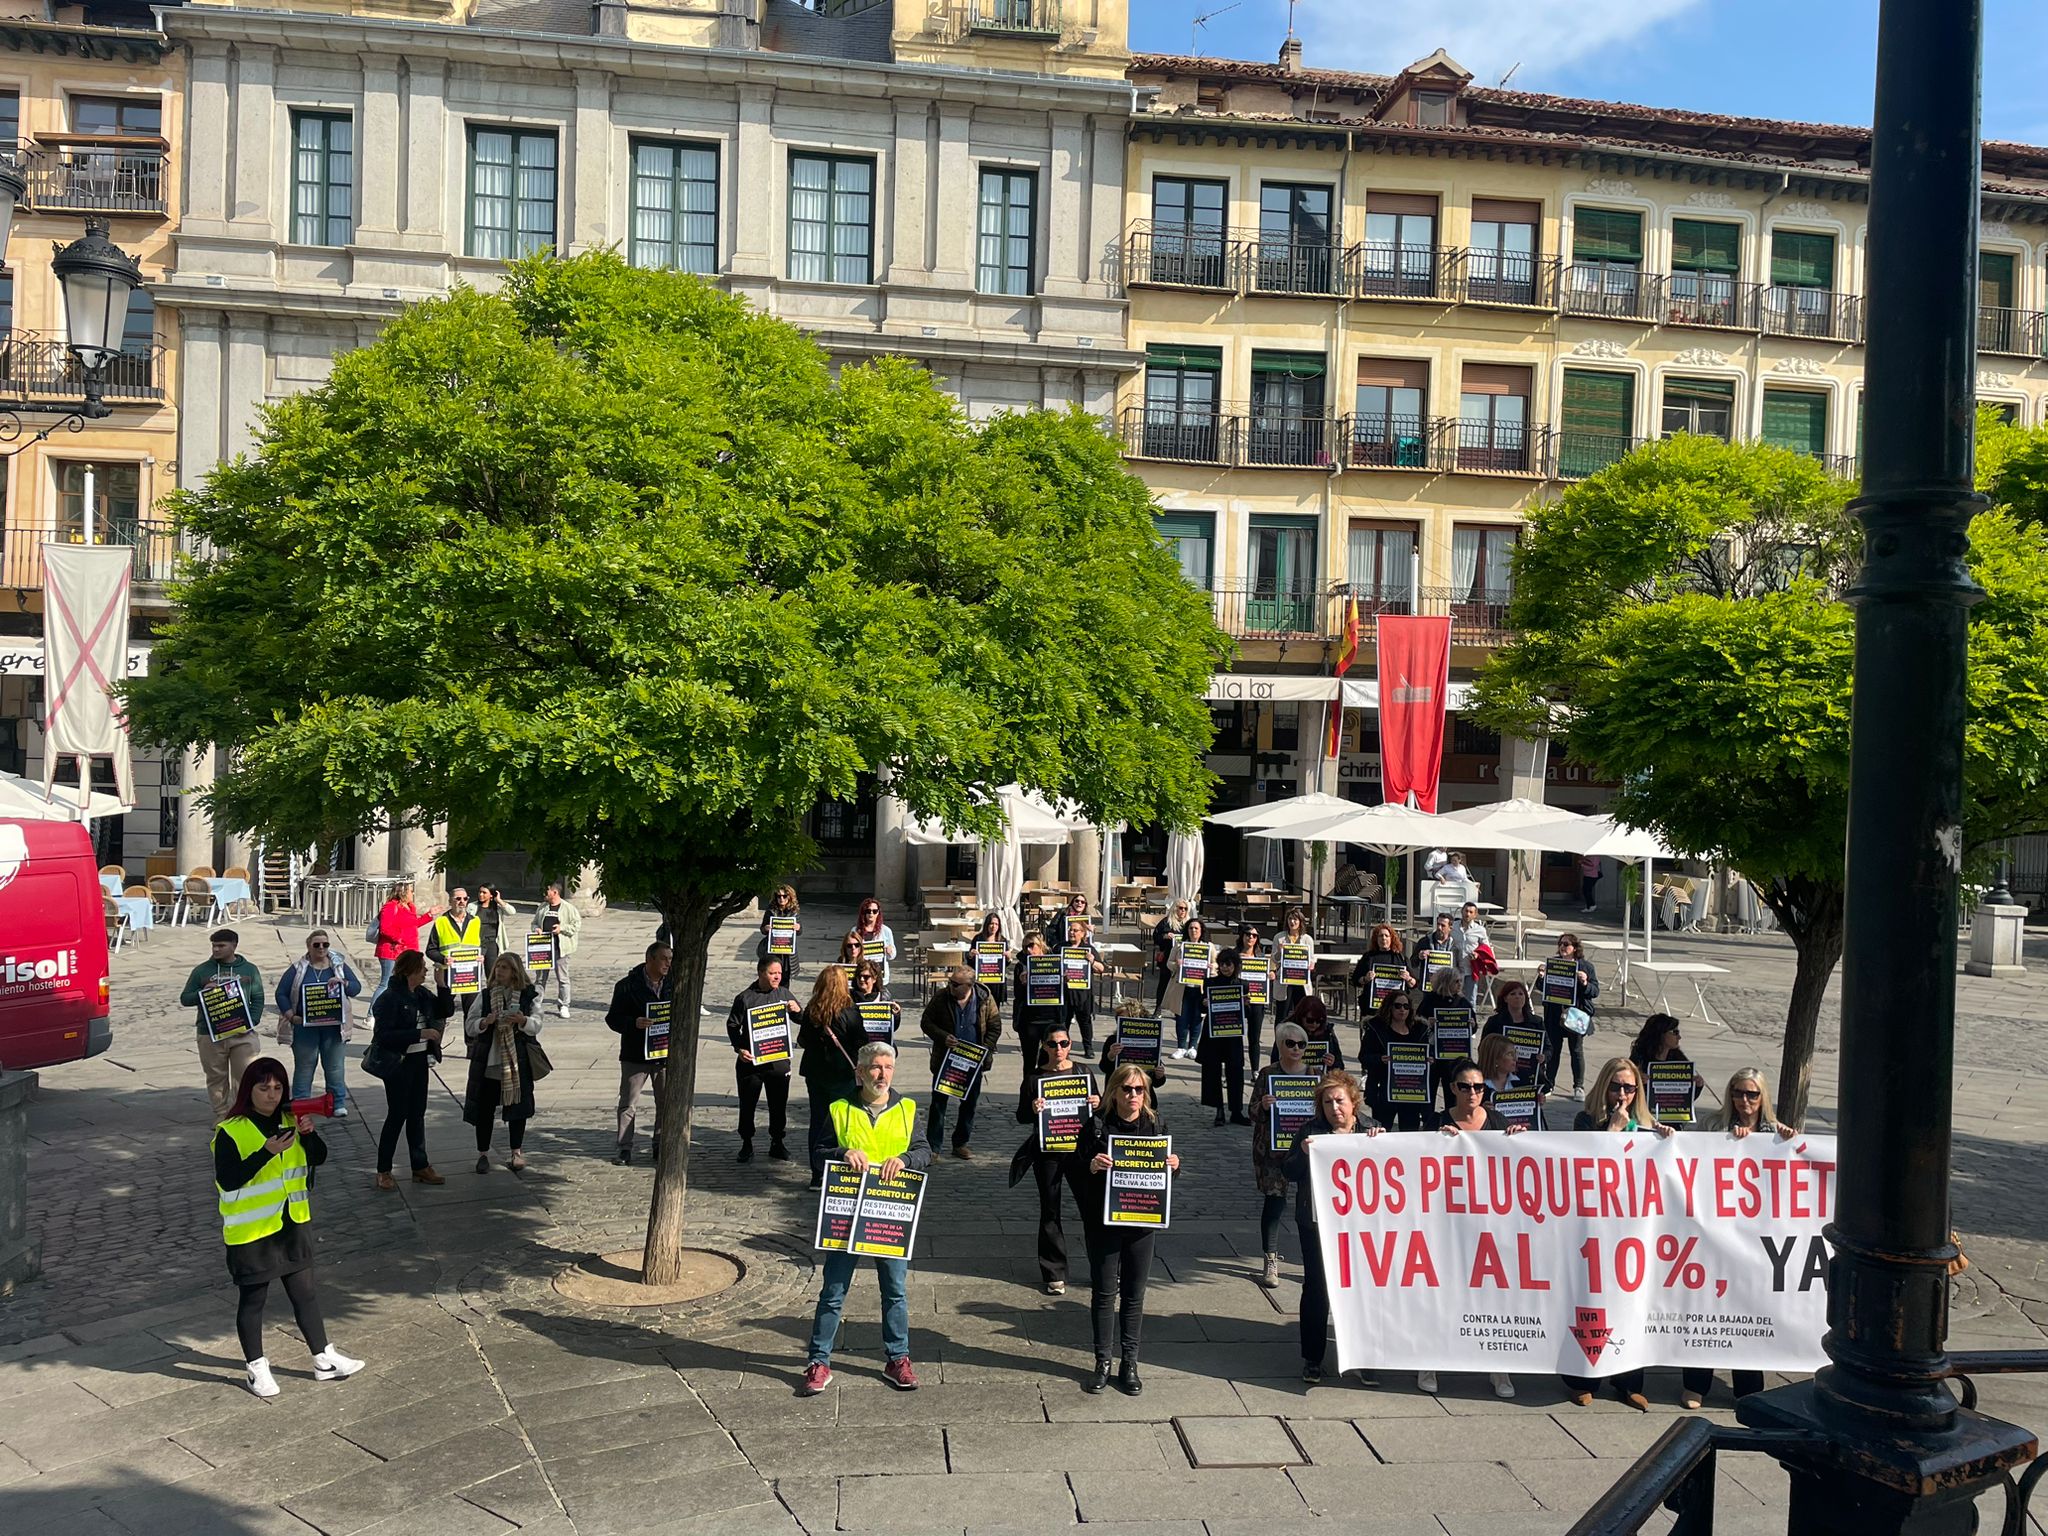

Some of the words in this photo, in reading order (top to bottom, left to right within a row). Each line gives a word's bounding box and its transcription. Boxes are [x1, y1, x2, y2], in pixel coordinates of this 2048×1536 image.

[1203, 678, 1242, 698] ñía
[1249, 678, 1275, 698] bar
[70, 949, 78, 974] grupo
[29, 979, 71, 991] hostelero
[1122, 1027, 1159, 1035] PERSONAS
[1043, 1080, 1080, 1088] ATENDEMOS
[1044, 1087, 1087, 1097] PERSONAS
[1496, 1092, 1536, 1100] PERSONAS
[1114, 1140, 1168, 1148] RECLAMAMOS
[1136, 1150, 1154, 1158] REAL
[1115, 1160, 1150, 1168] DECRETO
[840, 1175, 851, 1183] UN
[1114, 1172, 1163, 1180] RESTITUCIÓN
[1331, 1157, 1406, 1216] SOS
[1420, 1139, 1664, 1224] PELUQUERÍA
[1676, 1158, 1698, 1217] Y
[866, 1188, 901, 1198] DECRETO
[901, 1191, 916, 1200] LEY
[864, 1201, 911, 1212] RESTITUCIÓN
[1338, 1231, 1440, 1288] IVA
[1469, 1232, 1551, 1290] AL
[1580, 1234, 1728, 1298] 10%,
[1463, 1314, 1499, 1325] CONTRA
[1501, 1315, 1512, 1325] LA
[1514, 1315, 1542, 1326] RUINA
[1580, 1312, 1598, 1322] IVA
[1647, 1312, 1683, 1322] ALIANZA
[1686, 1313, 1703, 1323] POR
[1706, 1314, 1717, 1323] LA
[1719, 1315, 1754, 1325] BAJADA
[1756, 1316, 1774, 1326] DEL
[1460, 1327, 1472, 1337] DE
[1474, 1328, 1490, 1338] LAS
[1492, 1327, 1546, 1339] PELUQUERÍA
[1574, 1329, 1587, 1339] AL
[1644, 1325, 1658, 1334] IVA
[1660, 1326, 1670, 1334] AL
[1673, 1326, 1690, 1335] 10%
[1693, 1327, 1699, 1335] A
[1701, 1327, 1718, 1336] LAS
[1720, 1327, 1775, 1338] PELUQUERÍA
[1479, 1341, 1485, 1350] Y
[1487, 1340, 1528, 1352] ESTÉTICA
[1684, 1339, 1689, 1348] Y
[1691, 1338, 1733, 1349] ESTÉTICA
